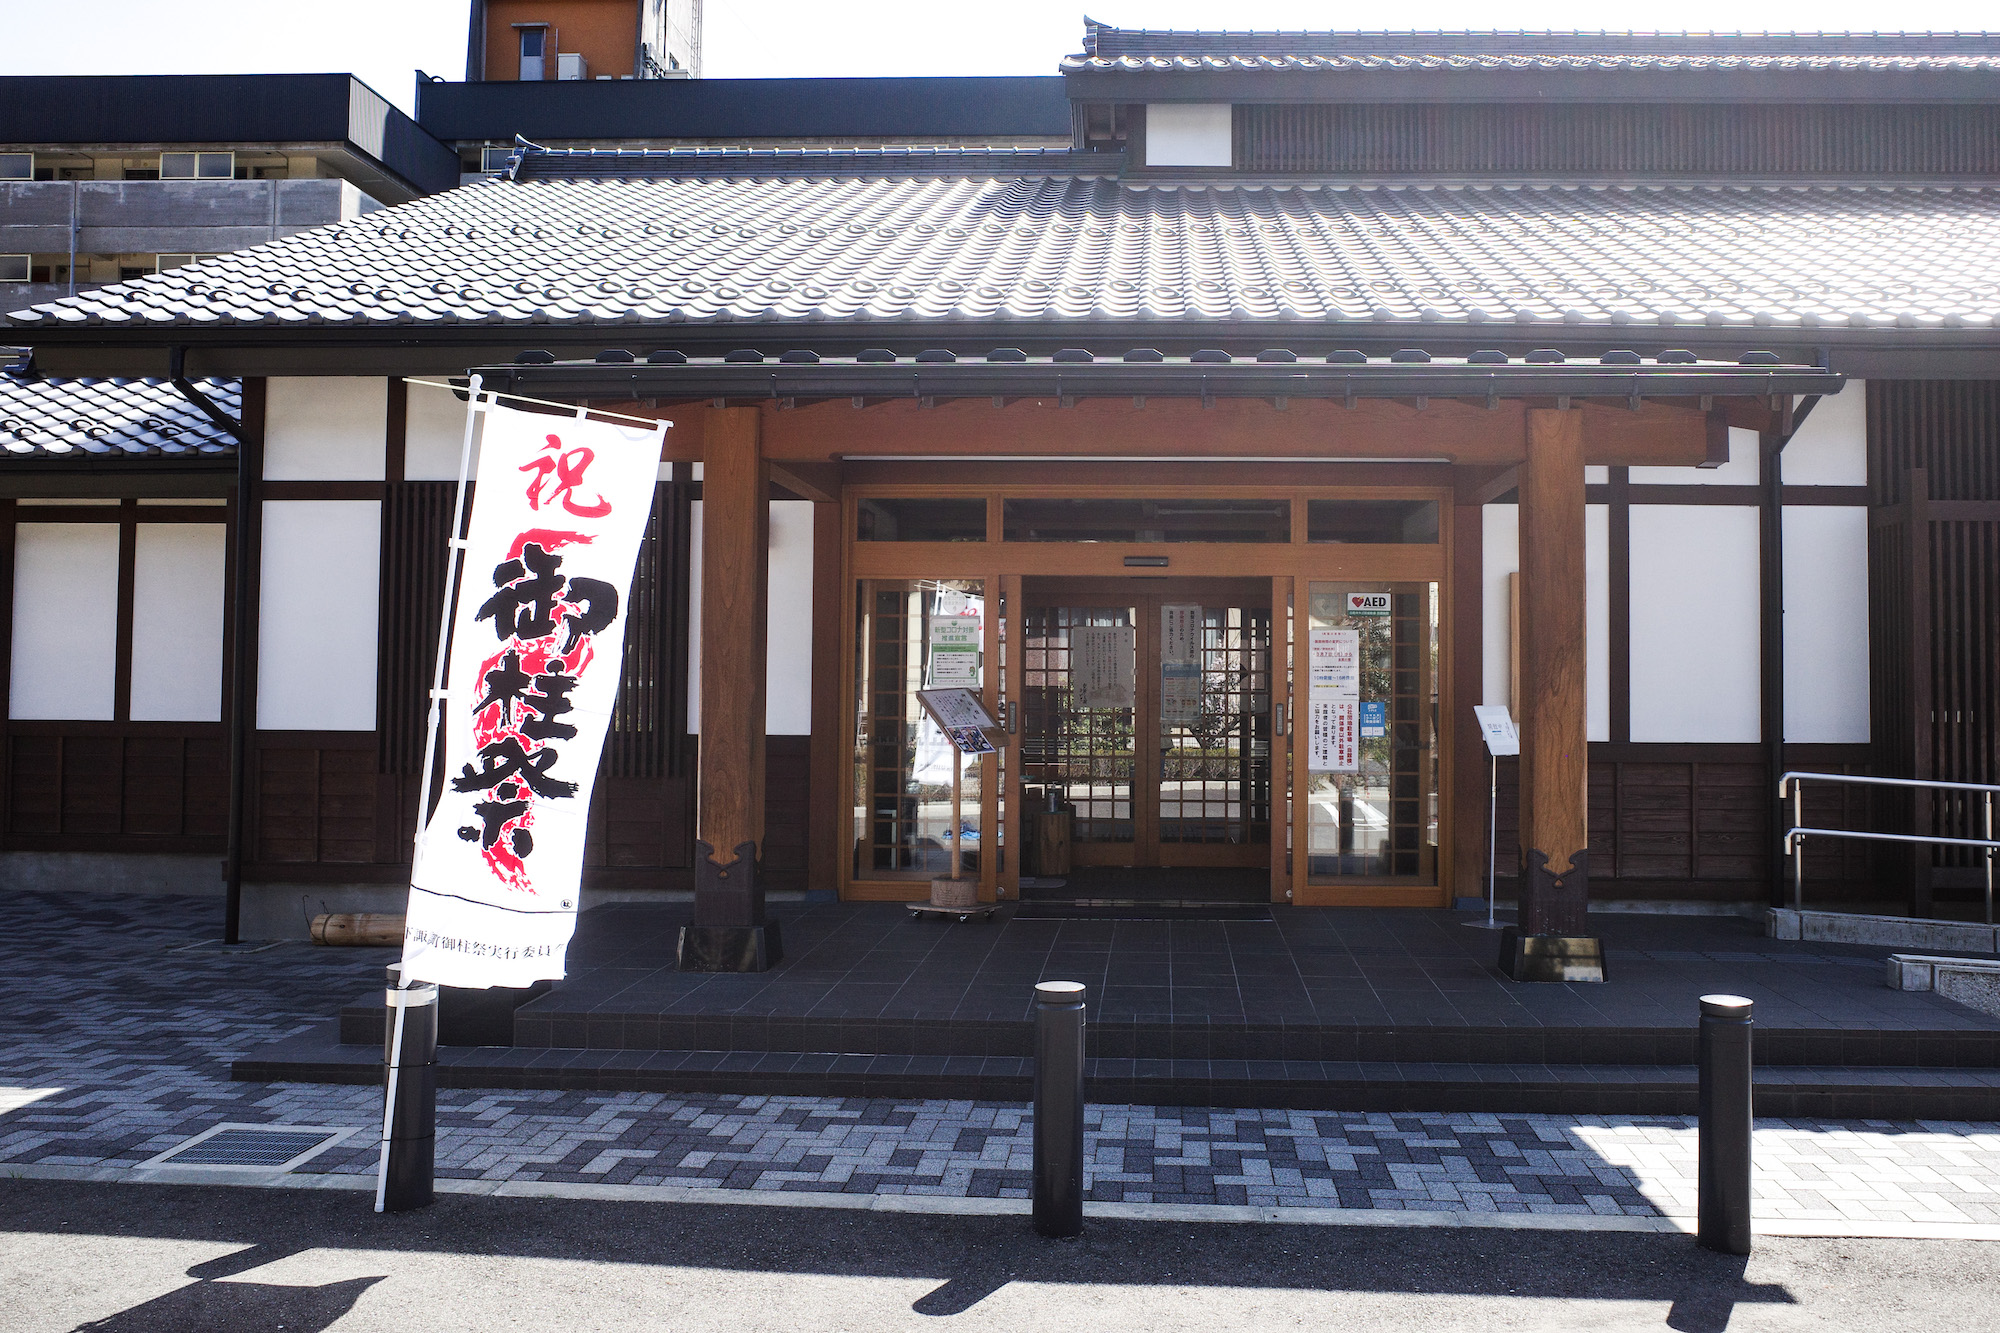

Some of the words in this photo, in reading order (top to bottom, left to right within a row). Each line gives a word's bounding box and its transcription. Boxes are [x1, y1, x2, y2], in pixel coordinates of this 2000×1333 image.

[517, 434, 612, 519] 祝
[1363, 597, 1386, 607] AED
[451, 543, 619, 858] 御柱祭
